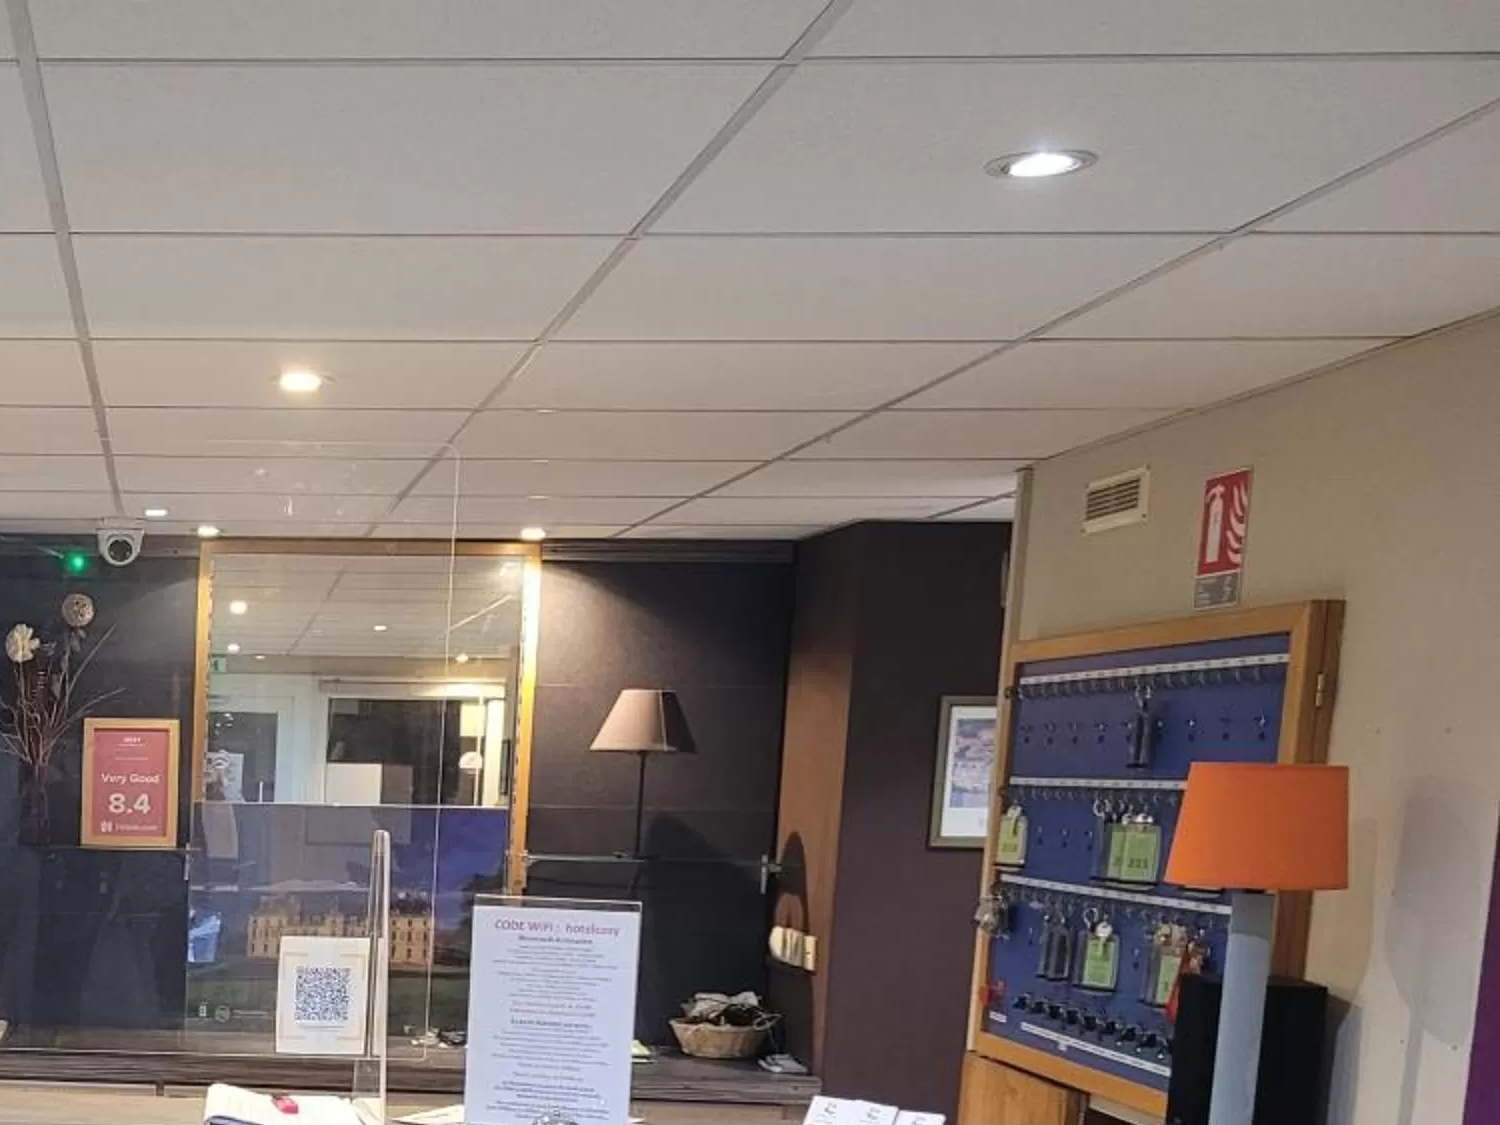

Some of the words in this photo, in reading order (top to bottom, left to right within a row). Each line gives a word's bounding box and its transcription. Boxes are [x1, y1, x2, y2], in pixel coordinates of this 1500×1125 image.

[101, 773, 127, 784] Very
[130, 773, 160, 783] Good
[108, 793, 151, 814] 8.4
[495, 919, 525, 930] CODE
